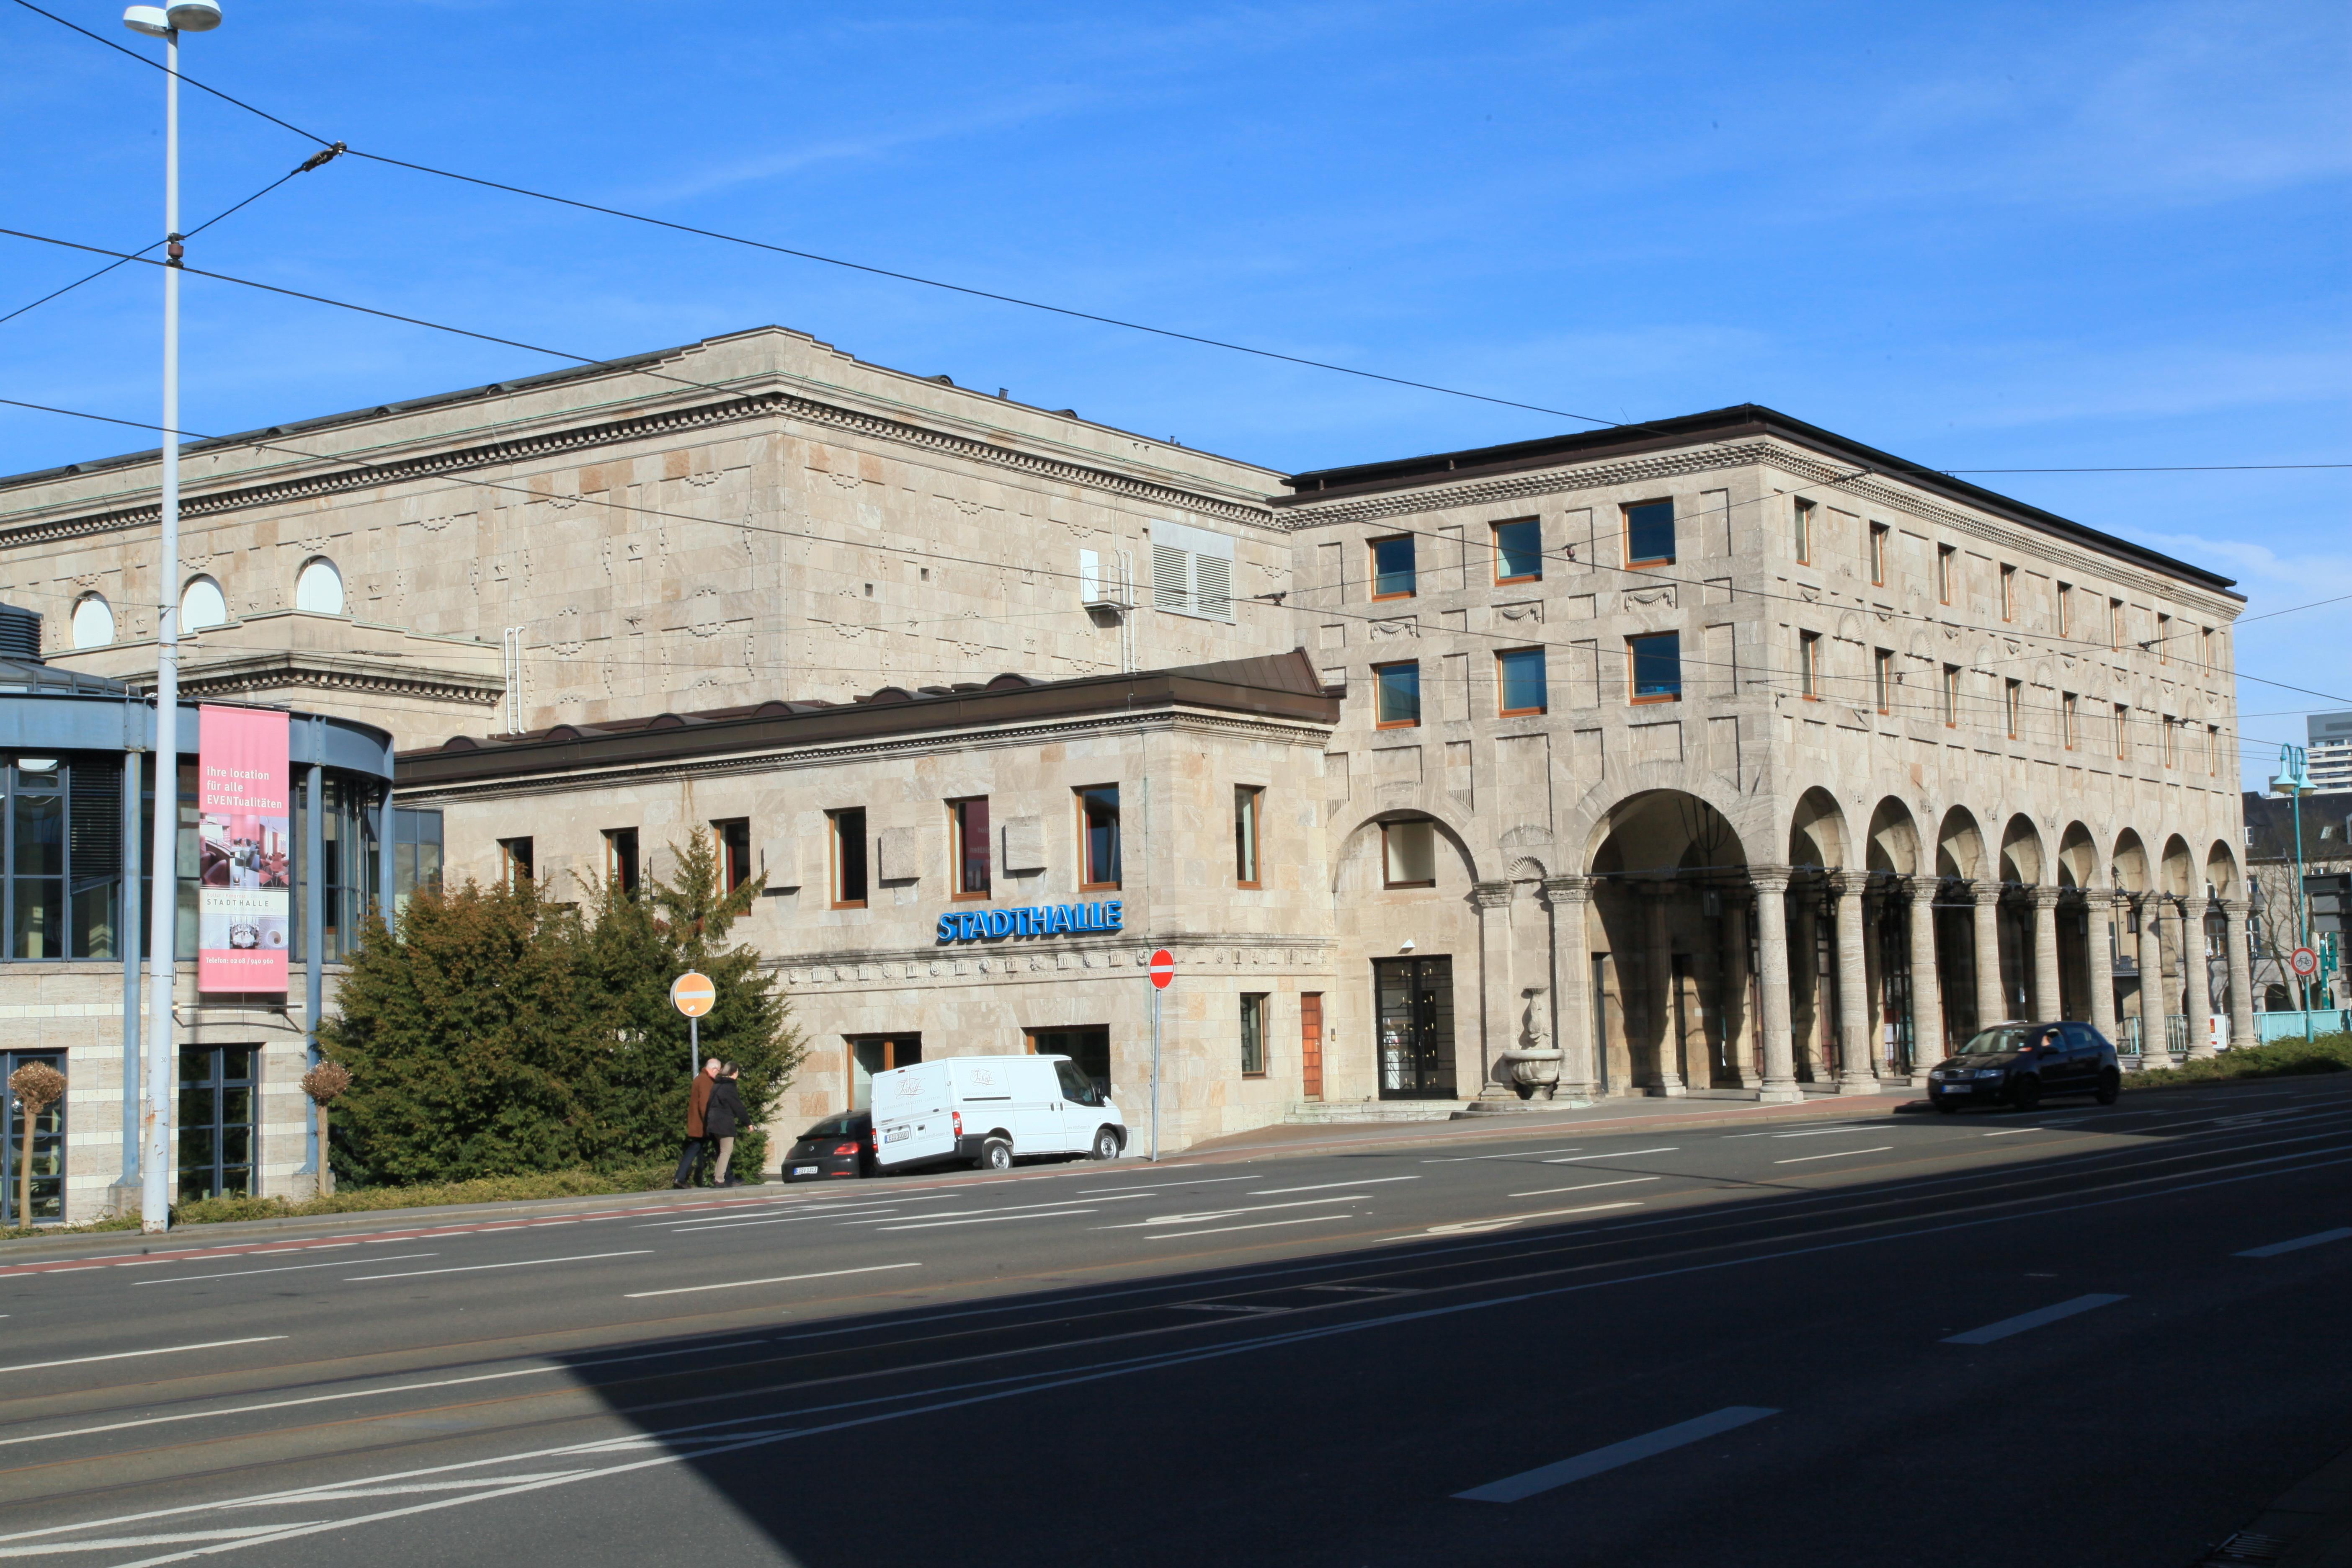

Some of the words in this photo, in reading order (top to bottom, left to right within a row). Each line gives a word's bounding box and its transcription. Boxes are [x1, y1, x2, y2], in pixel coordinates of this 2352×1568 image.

[207, 766, 227, 777] ihre
[230, 768, 269, 780] location
[207, 780, 221, 791] für
[224, 782, 243, 792] alle
[207, 794, 282, 809] EVENTualitäten
[937, 900, 1124, 942] STADTHALLE
[894, 1077, 926, 1099] Imhoff
